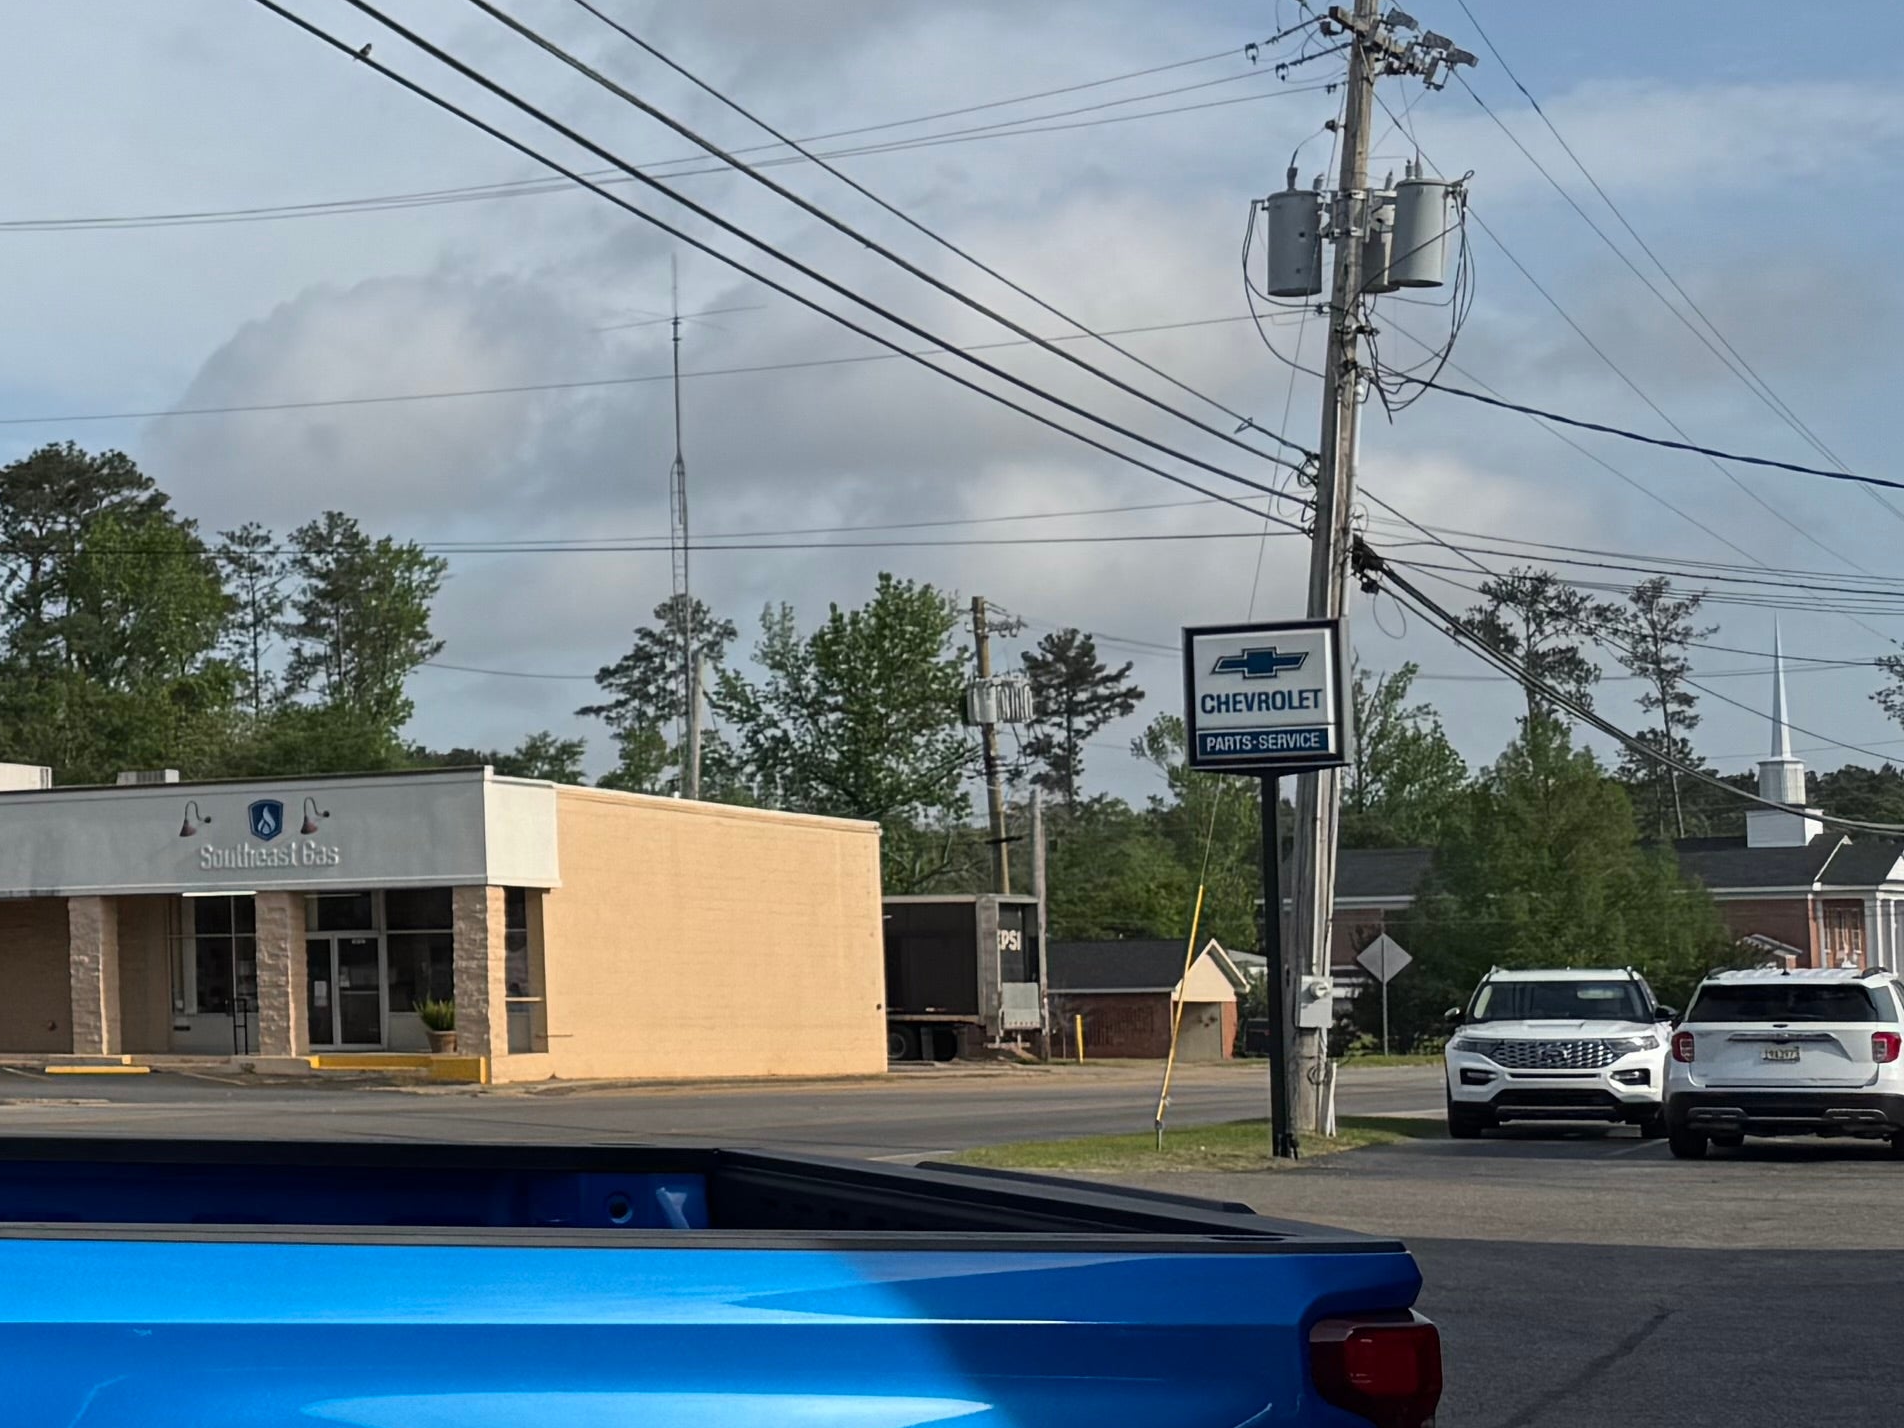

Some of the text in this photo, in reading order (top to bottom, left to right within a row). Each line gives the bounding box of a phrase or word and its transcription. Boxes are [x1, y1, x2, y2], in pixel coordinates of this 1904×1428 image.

[1200, 688, 1323, 714] CHEVROLET
[1206, 732, 1320, 752] PARTS SERVICE
[200, 838, 340, 870] Southeast Gas
[998, 929, 1021, 951] PSI
